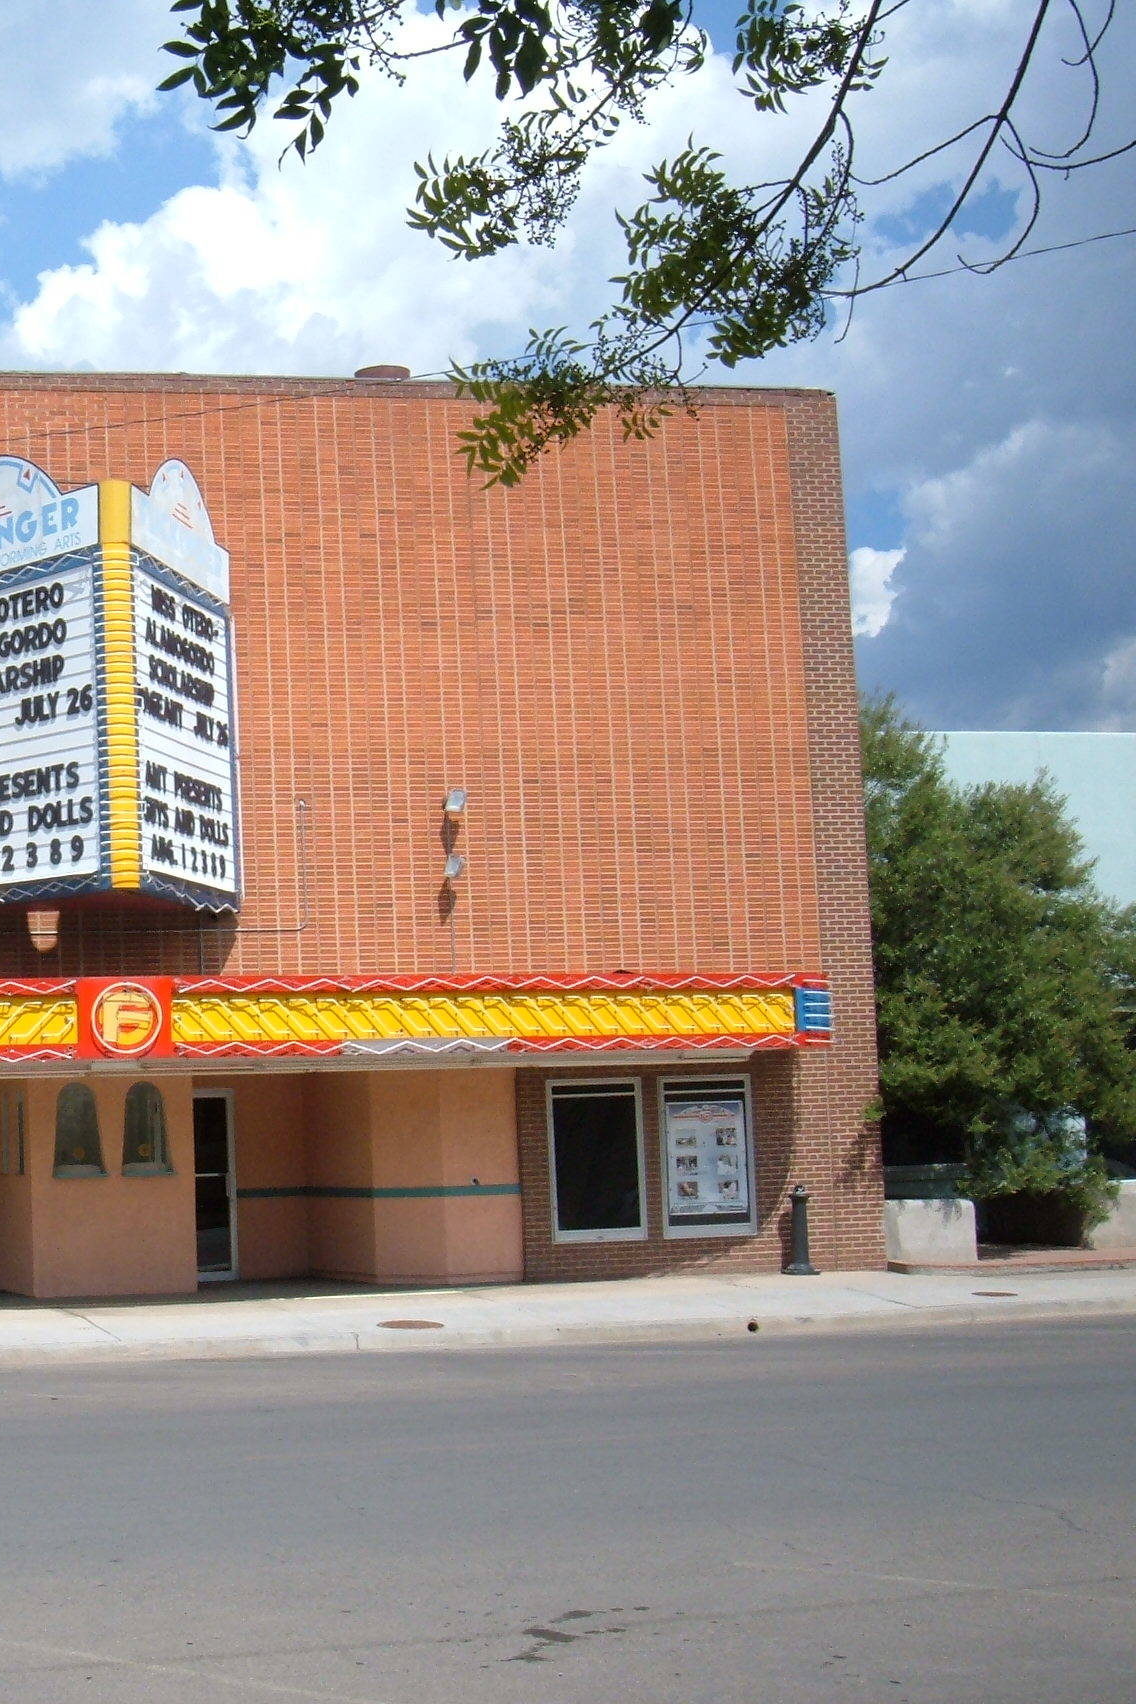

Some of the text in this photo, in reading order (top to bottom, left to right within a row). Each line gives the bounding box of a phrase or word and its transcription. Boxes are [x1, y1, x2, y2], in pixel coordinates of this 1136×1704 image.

[55, 532, 81, 550] ARTS
[14, 691, 60, 725] JULY
[67, 684, 93, 715] 26
[28, 796, 93, 832] DOLLS
[174, 807, 195, 836] AND
[199, 814, 228, 846] DOLLS
[2, 845, 14, 871] 2
[26, 842, 38, 868] 3
[49, 838, 62, 865] 8
[70, 835, 84, 862] 9
[182, 843, 186, 869] 1
[191, 847, 198, 872] 2
